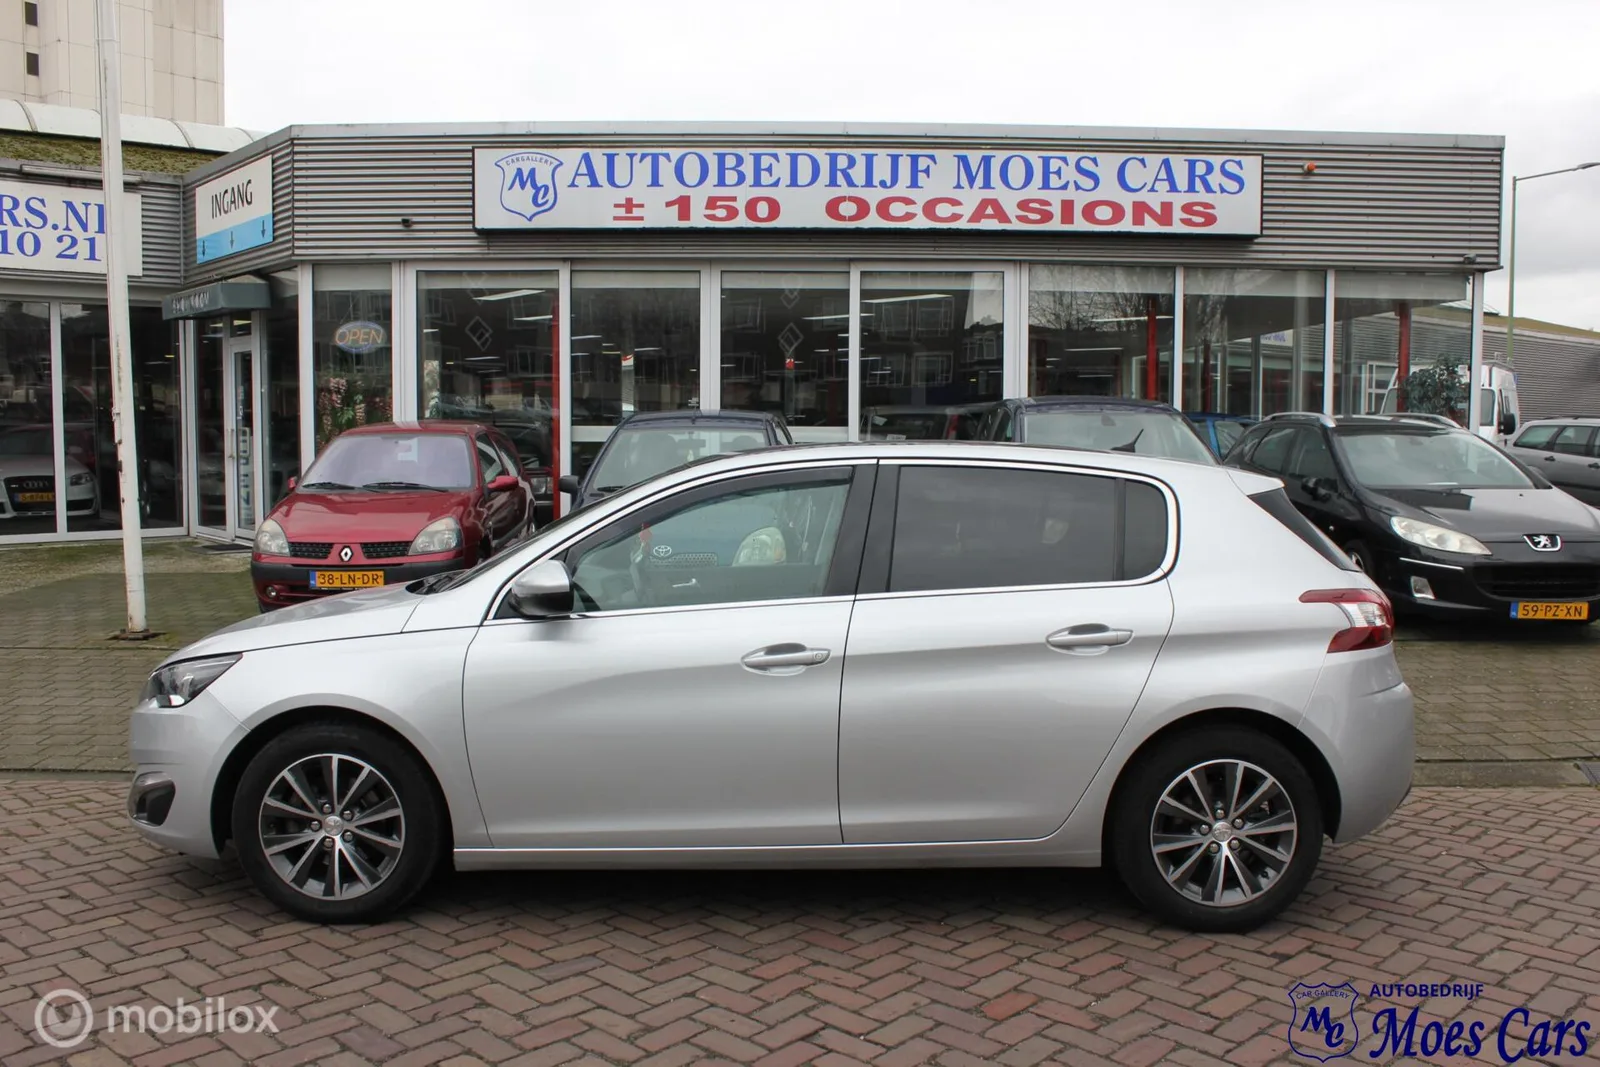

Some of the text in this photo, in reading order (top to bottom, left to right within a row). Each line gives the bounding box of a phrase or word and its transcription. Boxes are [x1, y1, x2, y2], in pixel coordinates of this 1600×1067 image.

[567, 152, 1246, 195] AUTOBEDRIJF MOES CARS
[211, 179, 253, 219] INGANG
[665, 194, 781, 223] 150
[825, 195, 1218, 227] OCCASIONS
[55, 234, 102, 261] 21
[335, 328, 383, 344] OPEN
[319, 573, 380, 585] 38-LN-DR
[1522, 604, 1583, 617] 59-PZ-XN
